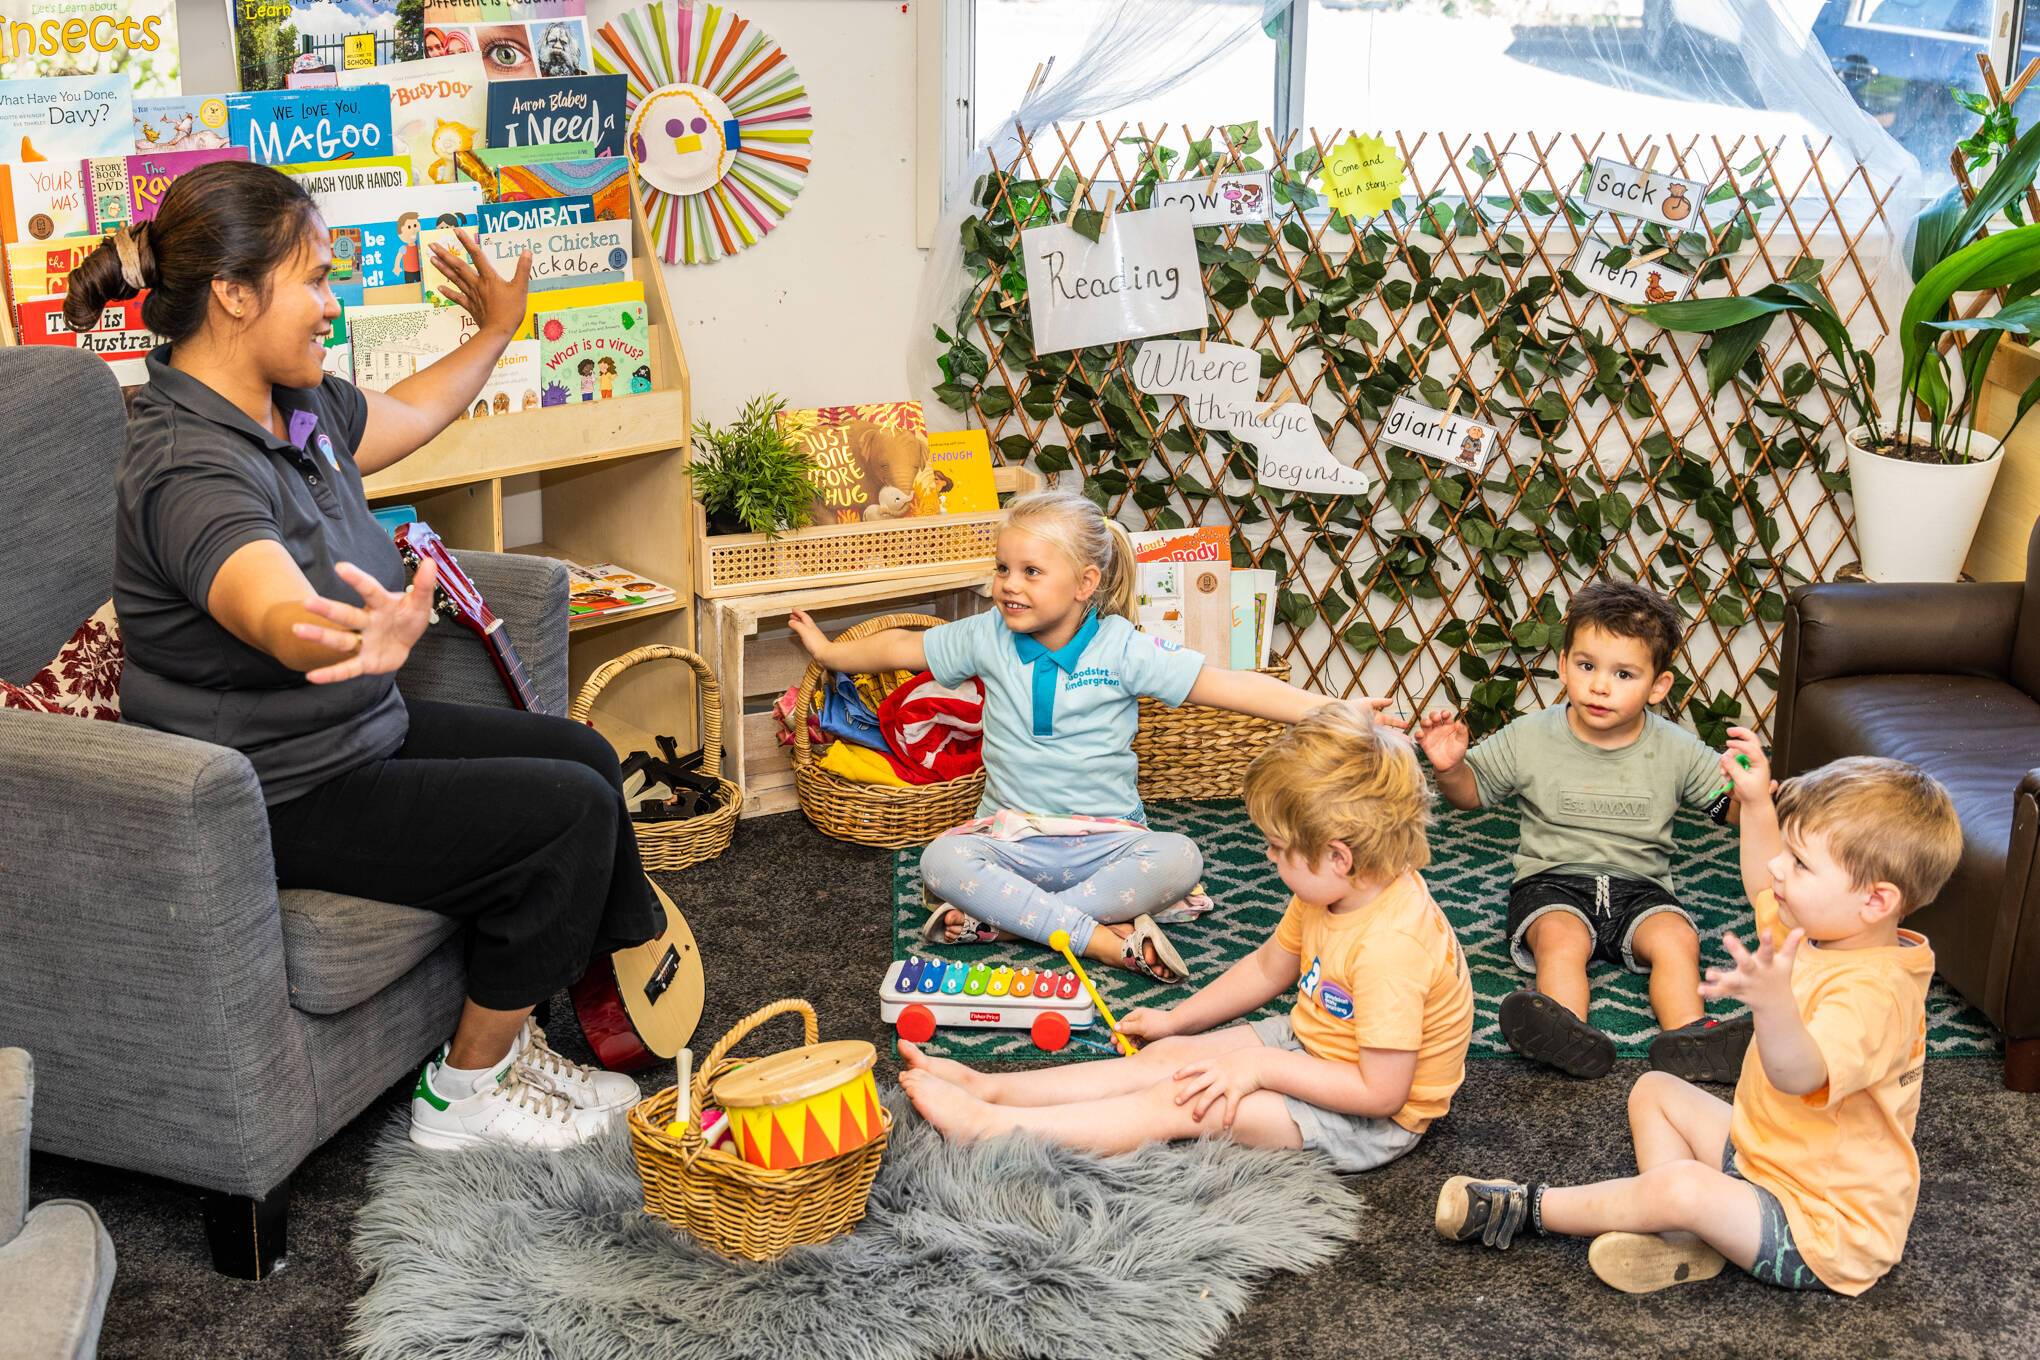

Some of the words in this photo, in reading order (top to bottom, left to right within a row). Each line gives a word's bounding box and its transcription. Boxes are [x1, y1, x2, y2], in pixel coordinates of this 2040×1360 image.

[58, 4, 87, 14] Learn
[89, 3, 118, 12] about
[246, 4, 291, 19] Learn
[27, 93, 57, 104] Have
[60, 91, 81, 102] You
[396, 81, 437, 106] Busy
[437, 80, 473, 98] Day
[512, 97, 546, 114] Aaron
[549, 89, 587, 111] Blabey
[48, 103, 110, 127] Davy?
[273, 106, 294, 120] WE
[302, 104, 329, 119] LOVE
[528, 99, 605, 149] Need
[604, 113, 615, 130] a
[249, 118, 381, 165] MAGOO
[95, 164, 122, 172] STORY
[96, 170, 123, 179] BOOK
[144, 162, 166, 175] The
[1333, 159, 1360, 177] Come
[1362, 154, 1385, 168] and
[30, 172, 73, 193] YOUR
[98, 181, 124, 192] DVD
[308, 176, 336, 194] WASH
[337, 174, 365, 191] YOUR
[367, 171, 402, 189] HANDS!
[1332, 187, 1353, 199] Tell
[51, 193, 79, 211] WAS
[484, 203, 590, 234] WOMBAT
[364, 231, 386, 247] be
[495, 238, 542, 260] Little
[549, 231, 621, 253] Chicken
[48, 256, 65, 269] the
[1041, 250, 1180, 309] Reading
[104, 310, 123, 329] is
[546, 342, 580, 371] What
[583, 338, 593, 351] is
[595, 338, 605, 349] a
[609, 337, 645, 361] virus?
[1140, 343, 1250, 389] Where
[1229, 410, 1310, 440] magic
[1387, 410, 1458, 447] giant
[804, 425, 850, 457] JUST
[816, 445, 856, 469] ONE
[931, 451, 973, 463] ENOUGH
[807, 463, 865, 489] MORE
[825, 484, 868, 507] HUG
[1171, 541, 1219, 562] Body
